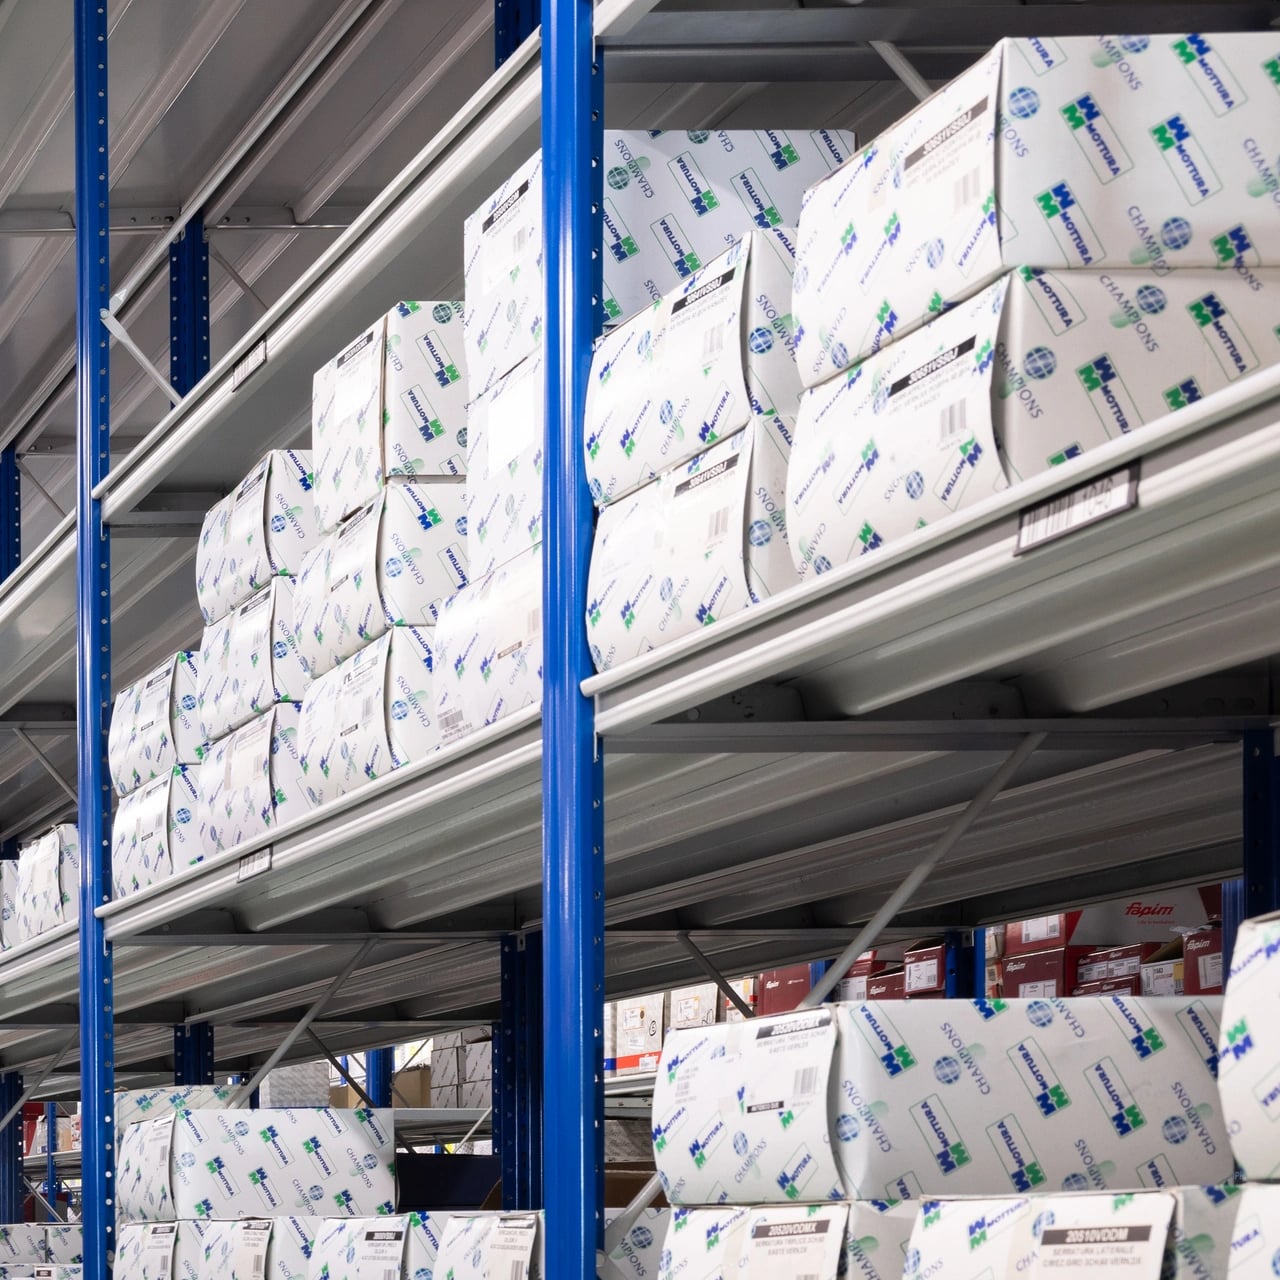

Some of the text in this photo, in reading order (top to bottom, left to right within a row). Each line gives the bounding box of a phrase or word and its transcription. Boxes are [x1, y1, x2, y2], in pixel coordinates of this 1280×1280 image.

[1198, 58, 1234, 110] MOTTURA
[614, 138, 654, 199] CHAMPIONS
[1086, 123, 1121, 177] MOTTURA
[676, 156, 702, 195] MOTTURA
[739, 172, 766, 212] MOTTURA
[1037, 277, 1073, 329] MOTTURA
[1099, 274, 1159, 354] CHAMPIONS
[1212, 320, 1248, 373] MOTTURA
[709, 390, 731, 428] MOTTURA
[391, 533, 425, 586] CHAMPIONS
[1125, 902, 1174, 918] fapim
[860, 1005, 894, 1050] MOTTURA
[940, 1021, 991, 1095] CHAMPIONS
[1018, 1043, 1049, 1091] MOTTURA
[217, 1114, 245, 1156] CHAMPIONS
[921, 1101, 953, 1148] MOTTURA
[1171, 1080, 1216, 1155] CHAMPIONS
[270, 1140, 289, 1166] MOTTURA
[312, 1152, 332, 1177] MOTTURA
[346, 1147, 373, 1189] CHAMPIONS
[997, 1120, 1029, 1168] MOTTURA
